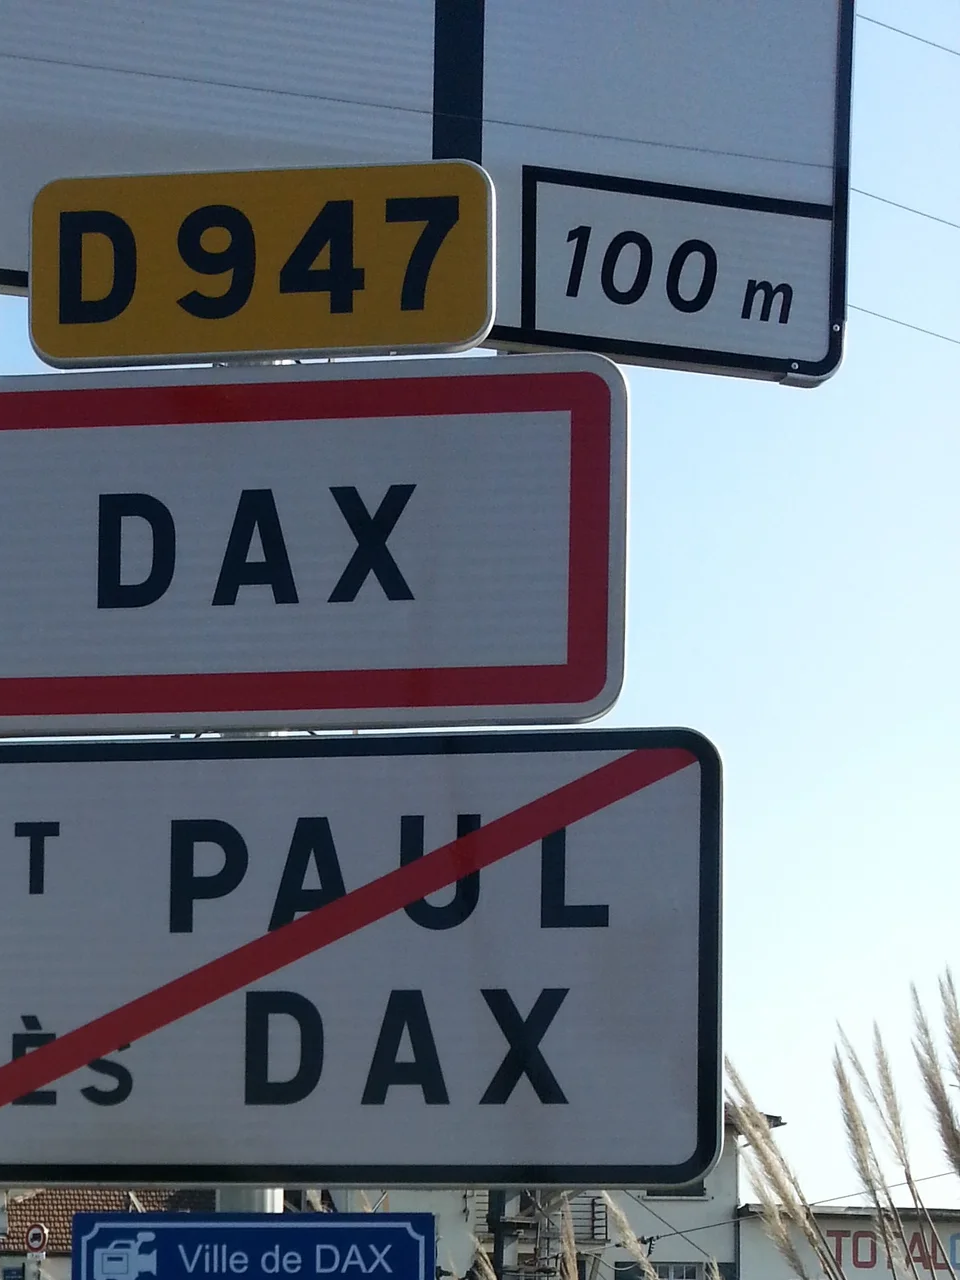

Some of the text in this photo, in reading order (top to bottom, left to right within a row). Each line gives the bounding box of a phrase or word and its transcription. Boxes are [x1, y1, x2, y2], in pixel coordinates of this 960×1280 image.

[58, 195, 460, 325] D 947
[565, 225, 794, 325] 100 m
[96, 484, 418, 609] DAX
[168, 814, 610, 934] PAUL
[244, 988, 570, 1106] DAX
[178, 1243, 393, 1274] Ville de DAX
